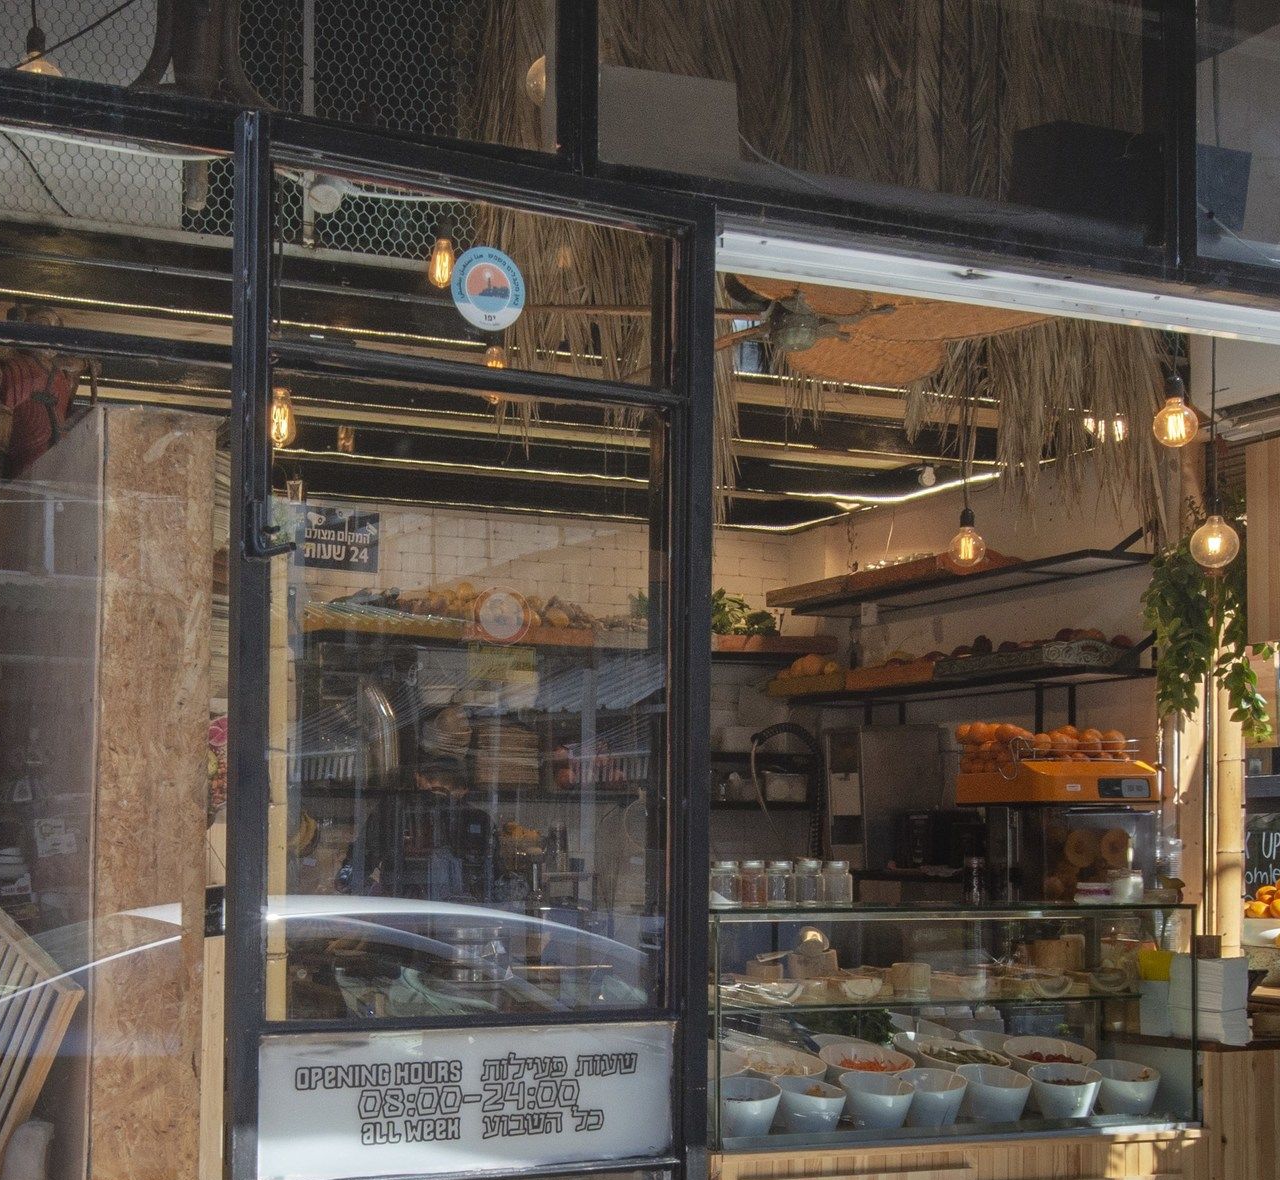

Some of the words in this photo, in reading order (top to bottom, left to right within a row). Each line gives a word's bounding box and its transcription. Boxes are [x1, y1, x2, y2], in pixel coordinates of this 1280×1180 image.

[304, 527, 336, 541] מצולם
[337, 530, 371, 545] המקום
[303, 542, 347, 562] שעות
[349, 547, 370, 563] 24
[394, 1060, 463, 1086] HOURS
[480, 1052, 568, 1082] פעילות
[576, 1052, 638, 1079] שעות
[482, 1110, 562, 1139] השבוע
[570, 1105, 605, 1131] כל
